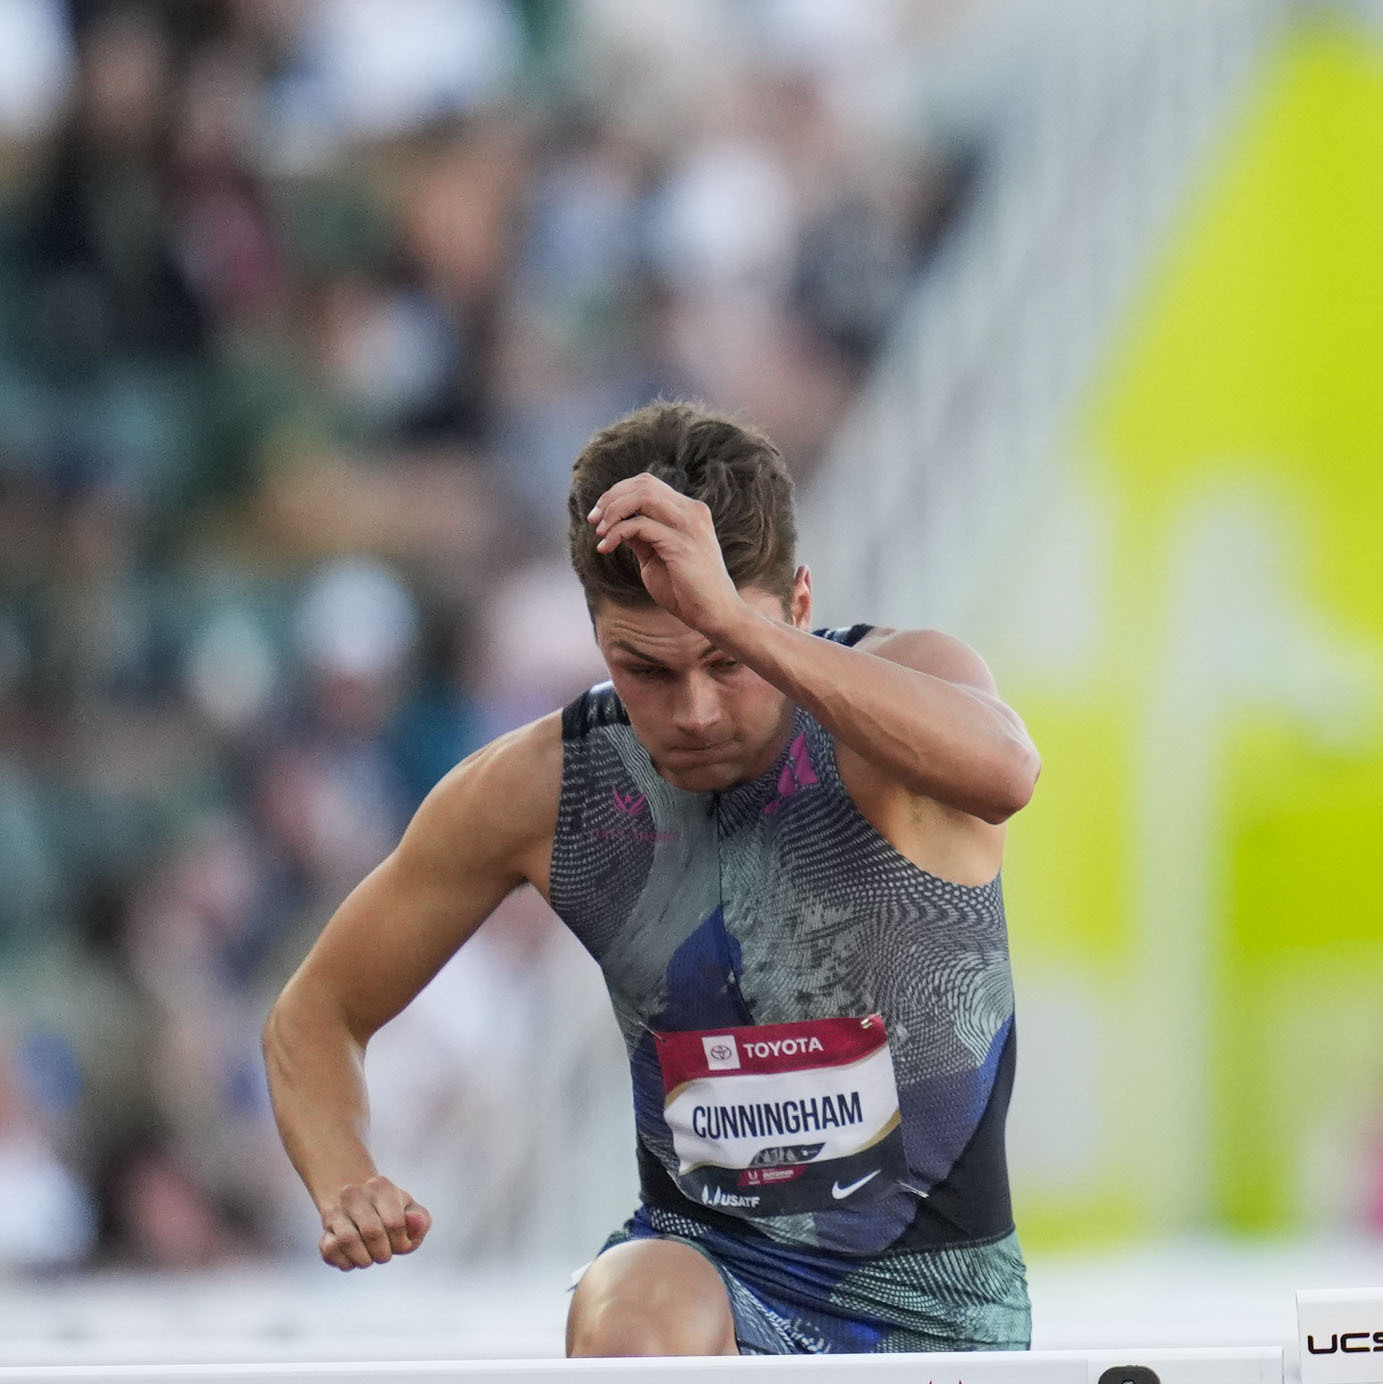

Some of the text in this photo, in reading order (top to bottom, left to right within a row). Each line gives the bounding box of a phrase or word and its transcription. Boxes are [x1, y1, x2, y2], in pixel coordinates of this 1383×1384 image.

[742, 1036, 824, 1060] TOYOTA
[692, 1091, 864, 1140] CUNNINGHAM
[720, 1194, 761, 1208] USATF
